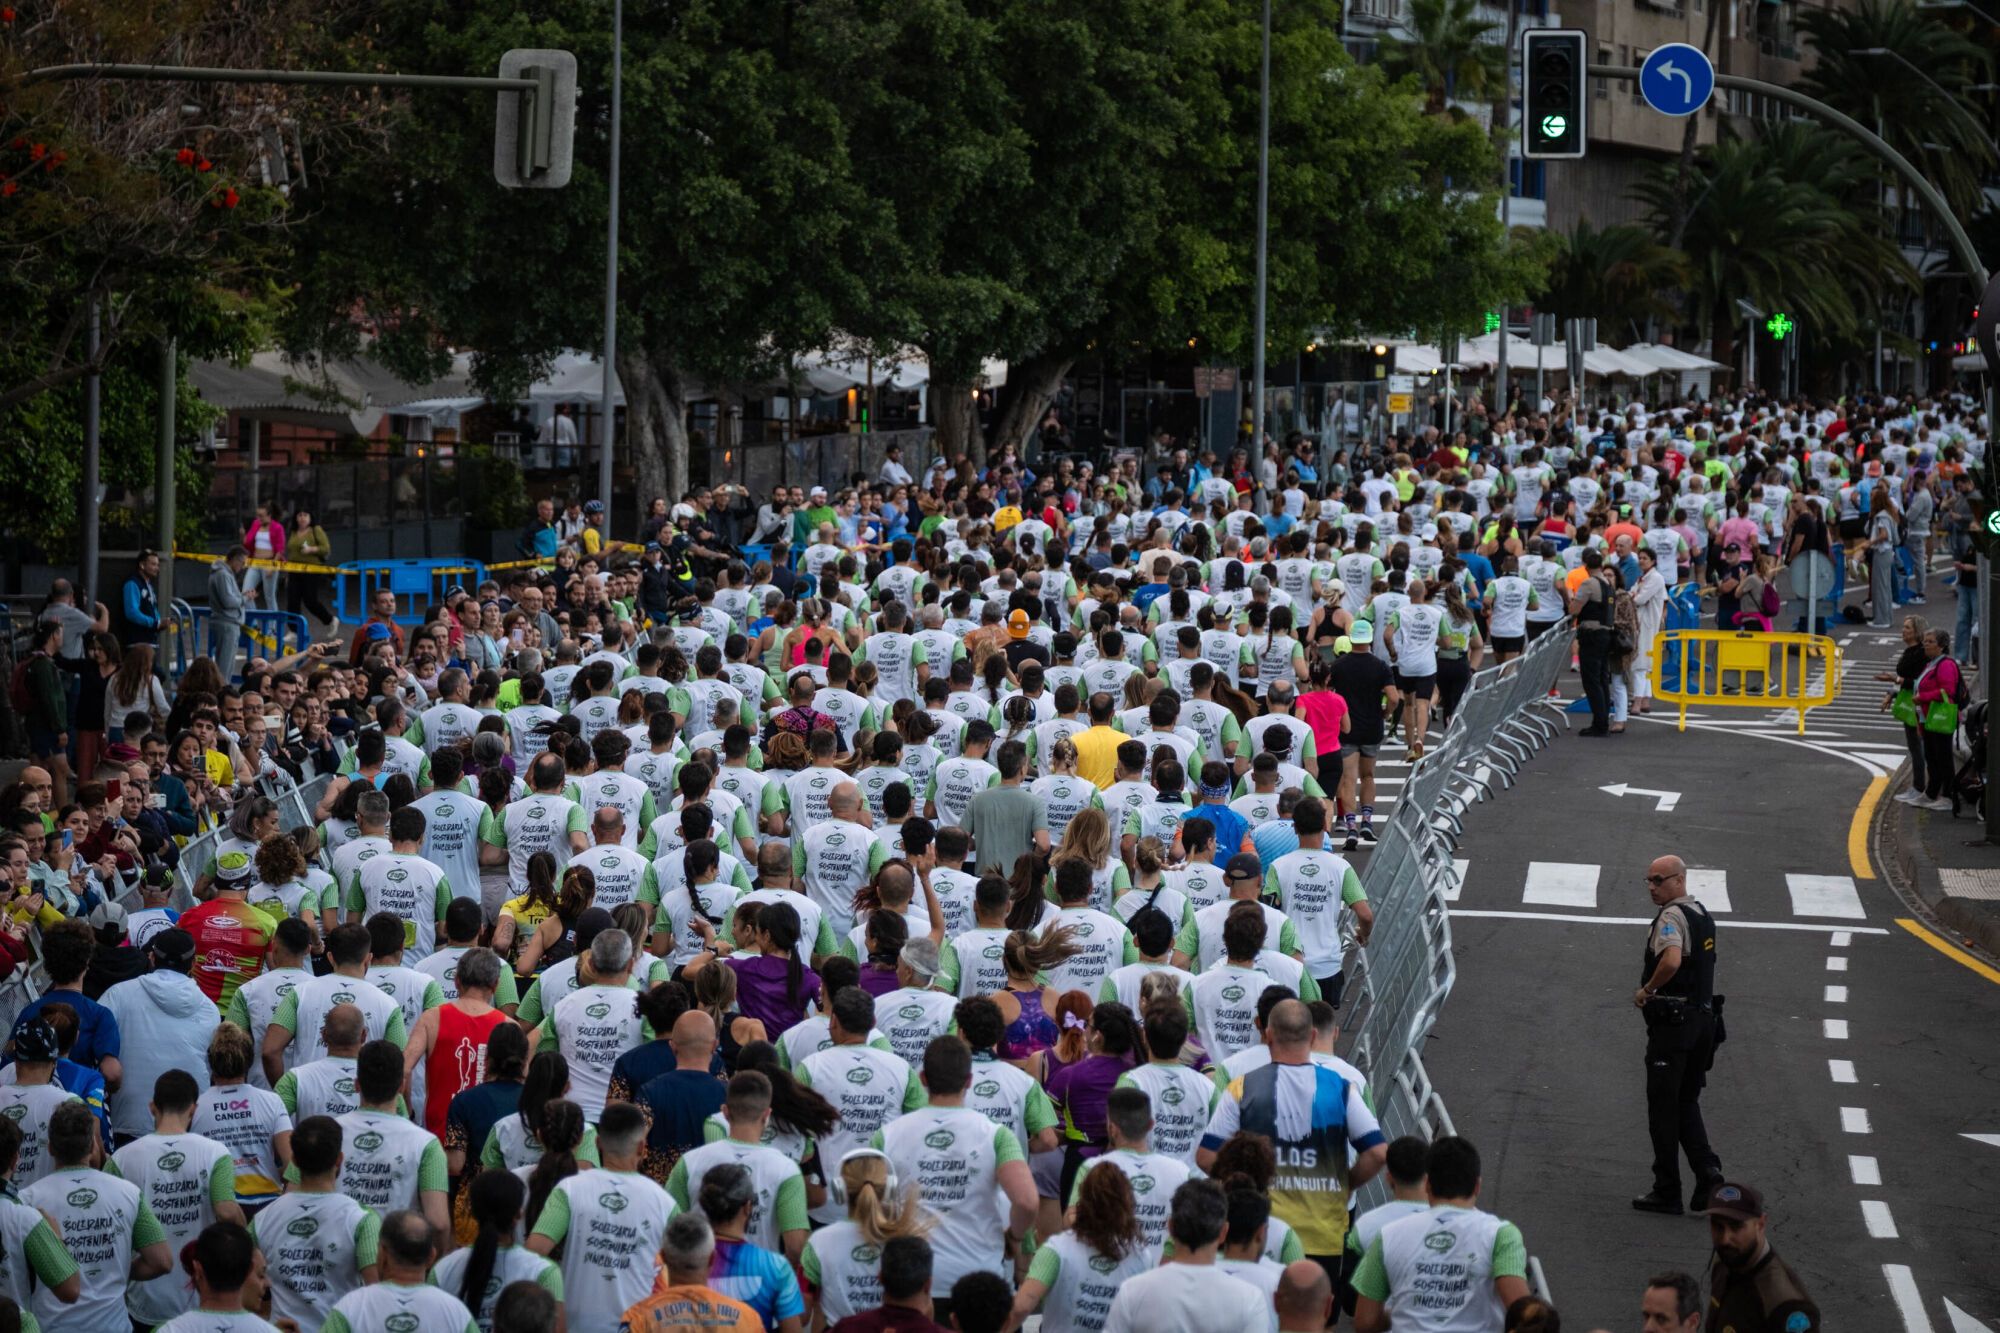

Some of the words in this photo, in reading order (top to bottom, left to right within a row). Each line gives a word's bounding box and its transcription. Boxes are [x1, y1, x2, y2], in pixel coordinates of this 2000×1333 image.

[214, 1111, 252, 1121] CANCER
[1275, 1146, 1317, 1168] LOS
[71, 1247, 115, 1265] NCLUSIVA
